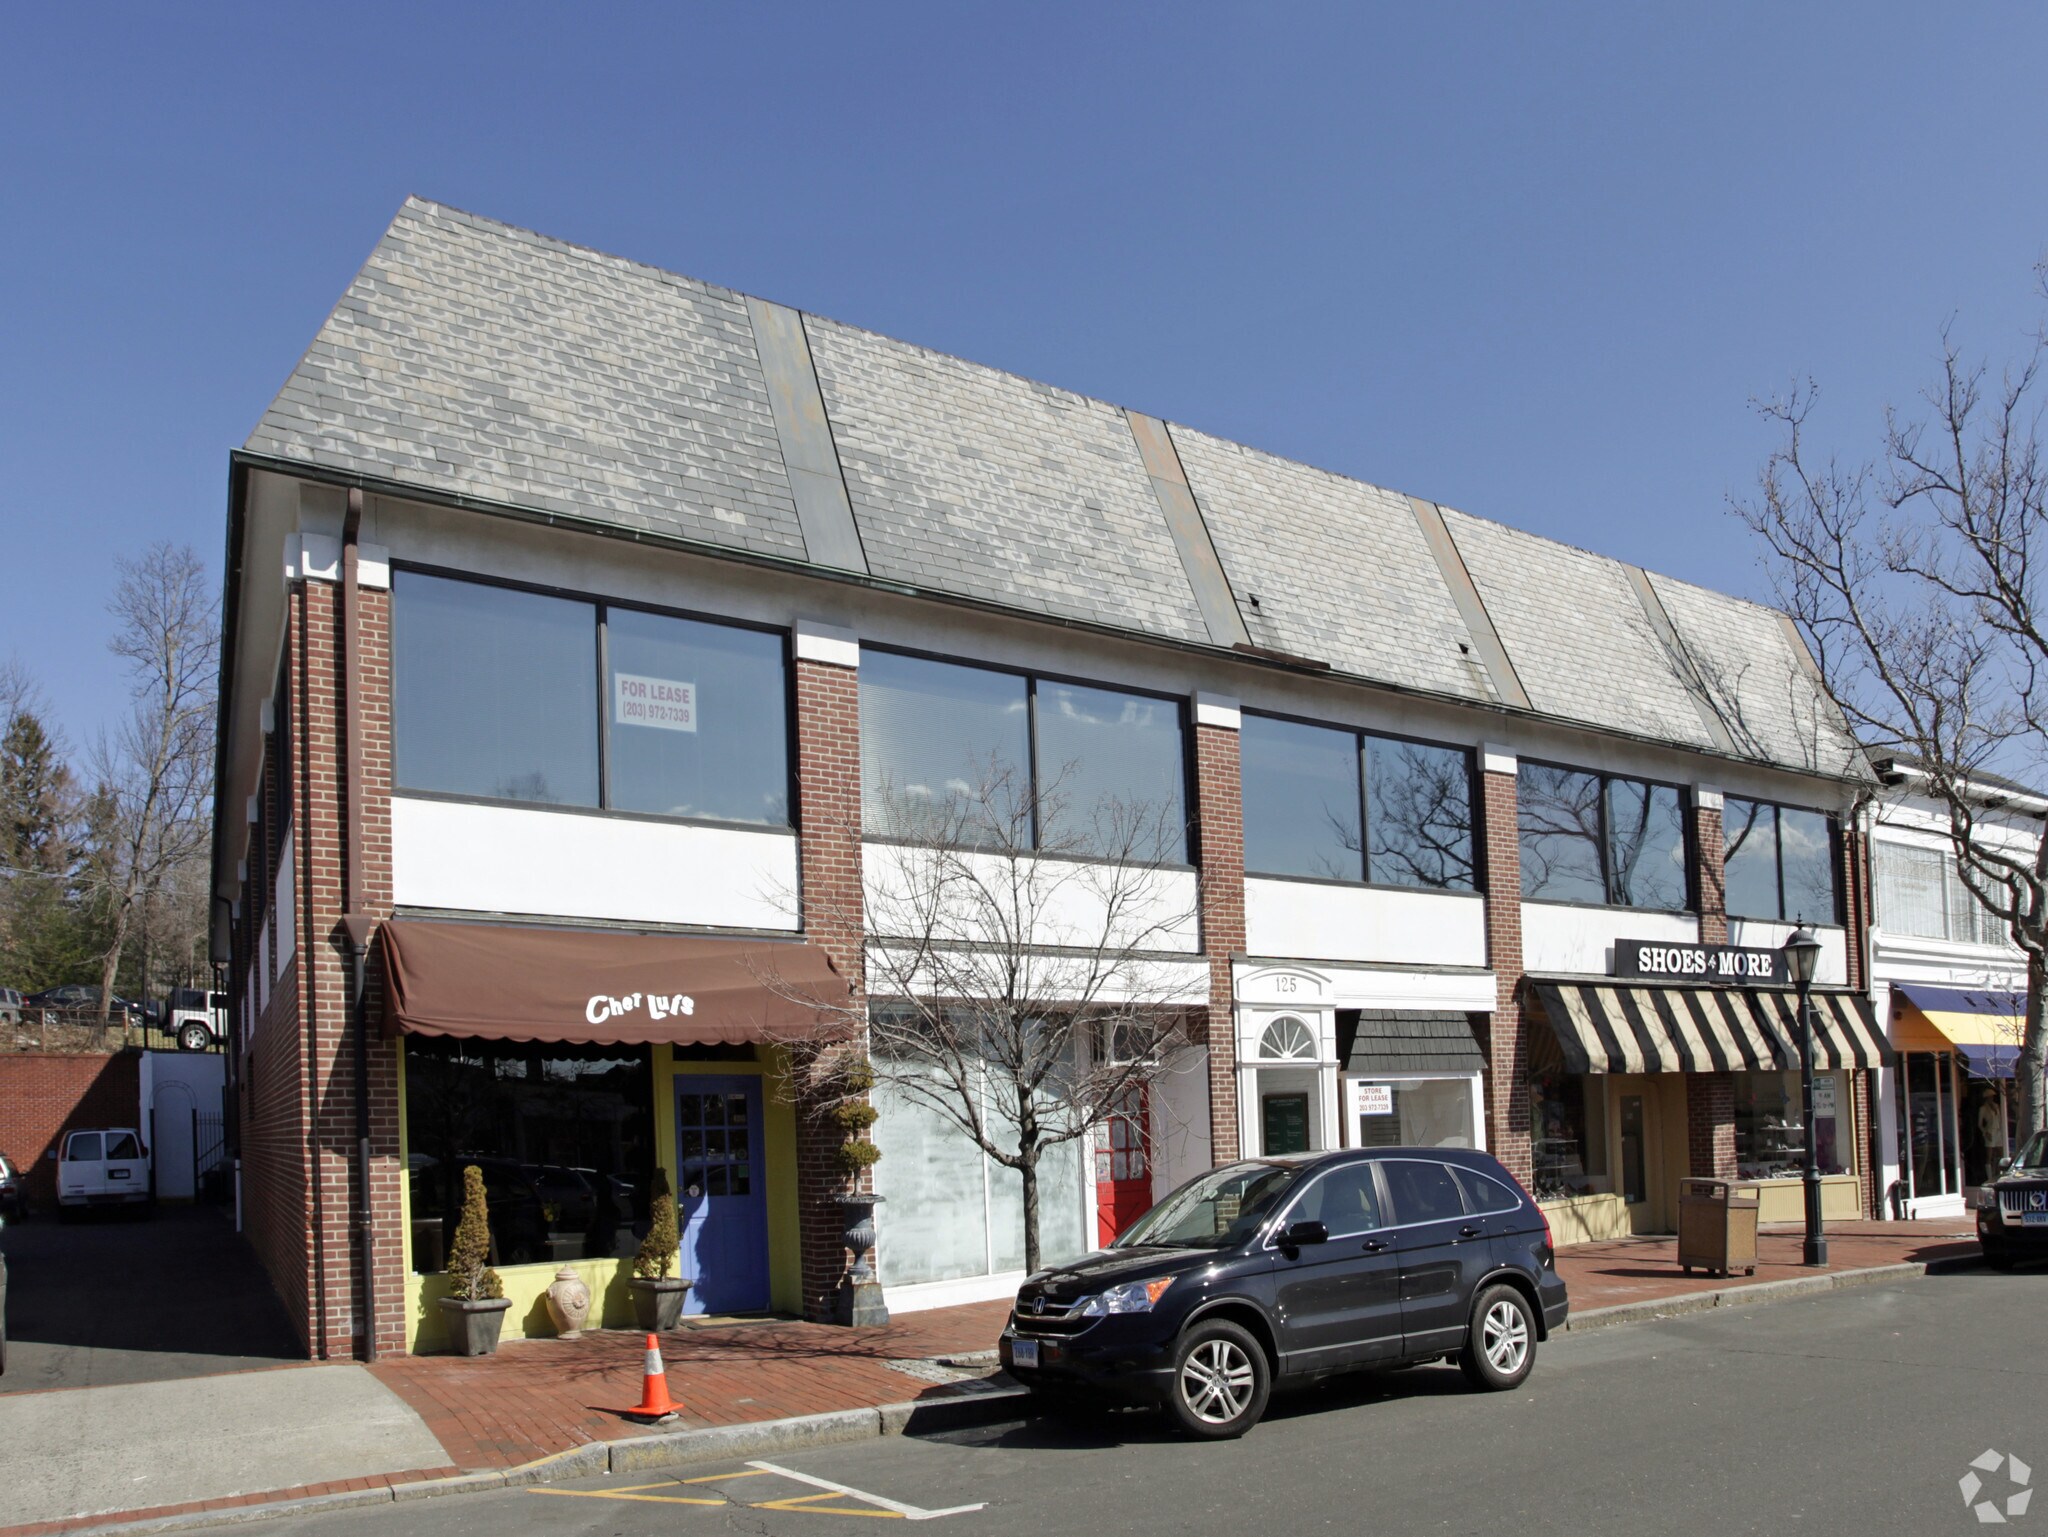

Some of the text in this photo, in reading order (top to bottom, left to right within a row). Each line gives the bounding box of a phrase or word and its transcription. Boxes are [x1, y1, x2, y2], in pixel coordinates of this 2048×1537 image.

[621, 680, 690, 704] FOR LEASE
[623, 701, 690, 723] (203) 972-7339
[1638, 947, 1706, 974] SHOES
[1718, 951, 1773, 977] MORE
[1276, 976, 1297, 993] 125
[585, 992, 695, 1024] Chef Luis
[1358, 1094, 1370, 1102] FOR
[1364, 1087, 1382, 1095] STORE
